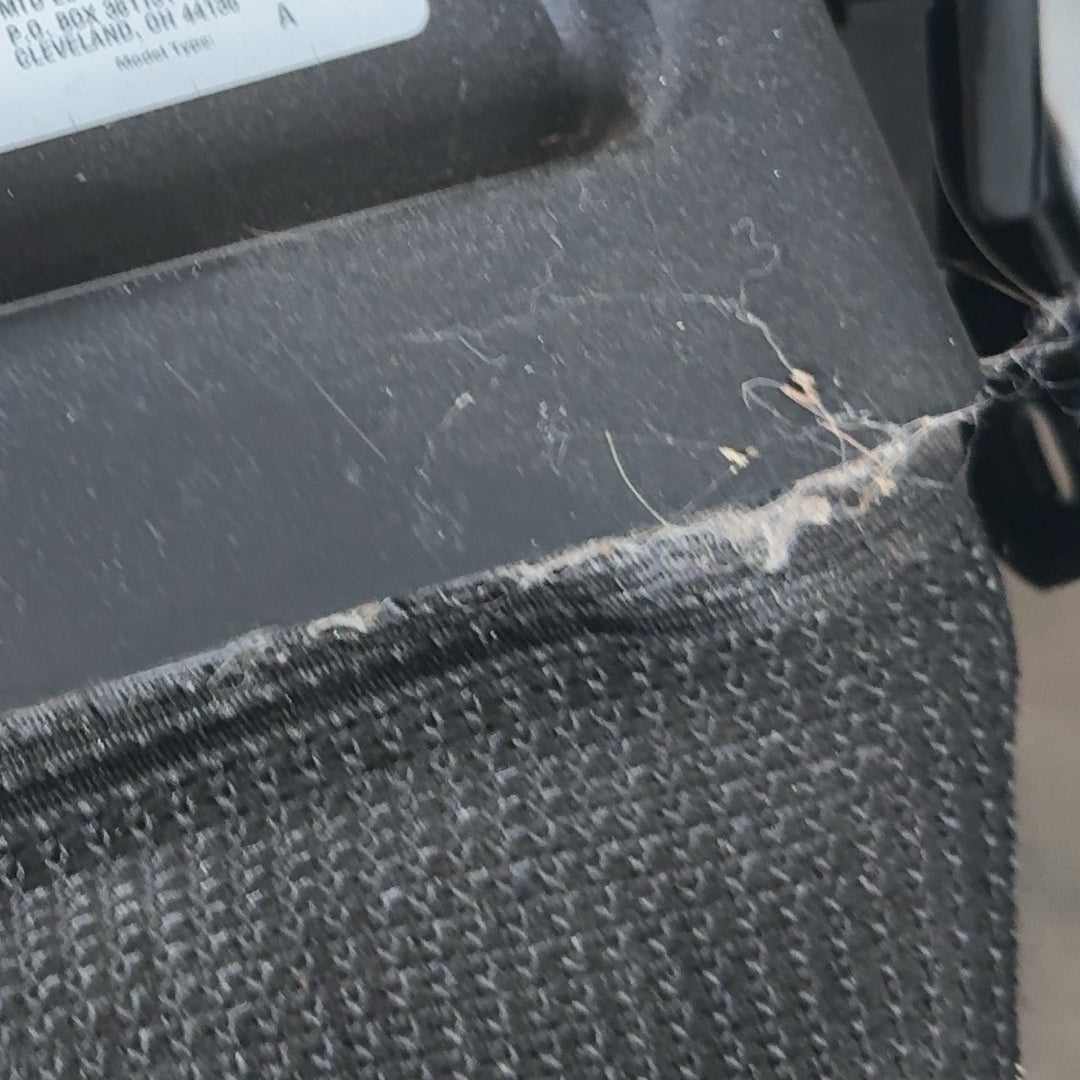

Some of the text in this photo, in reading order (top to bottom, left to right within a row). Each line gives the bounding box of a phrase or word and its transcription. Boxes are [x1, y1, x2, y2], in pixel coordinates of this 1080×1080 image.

[5, 18, 52, 46] P.O.
[55, 3, 100, 34] BOX
[276, 1, 298, 30] A
[13, 21, 143, 70] CLEVELAND,
[144, 9, 179, 35] OH
